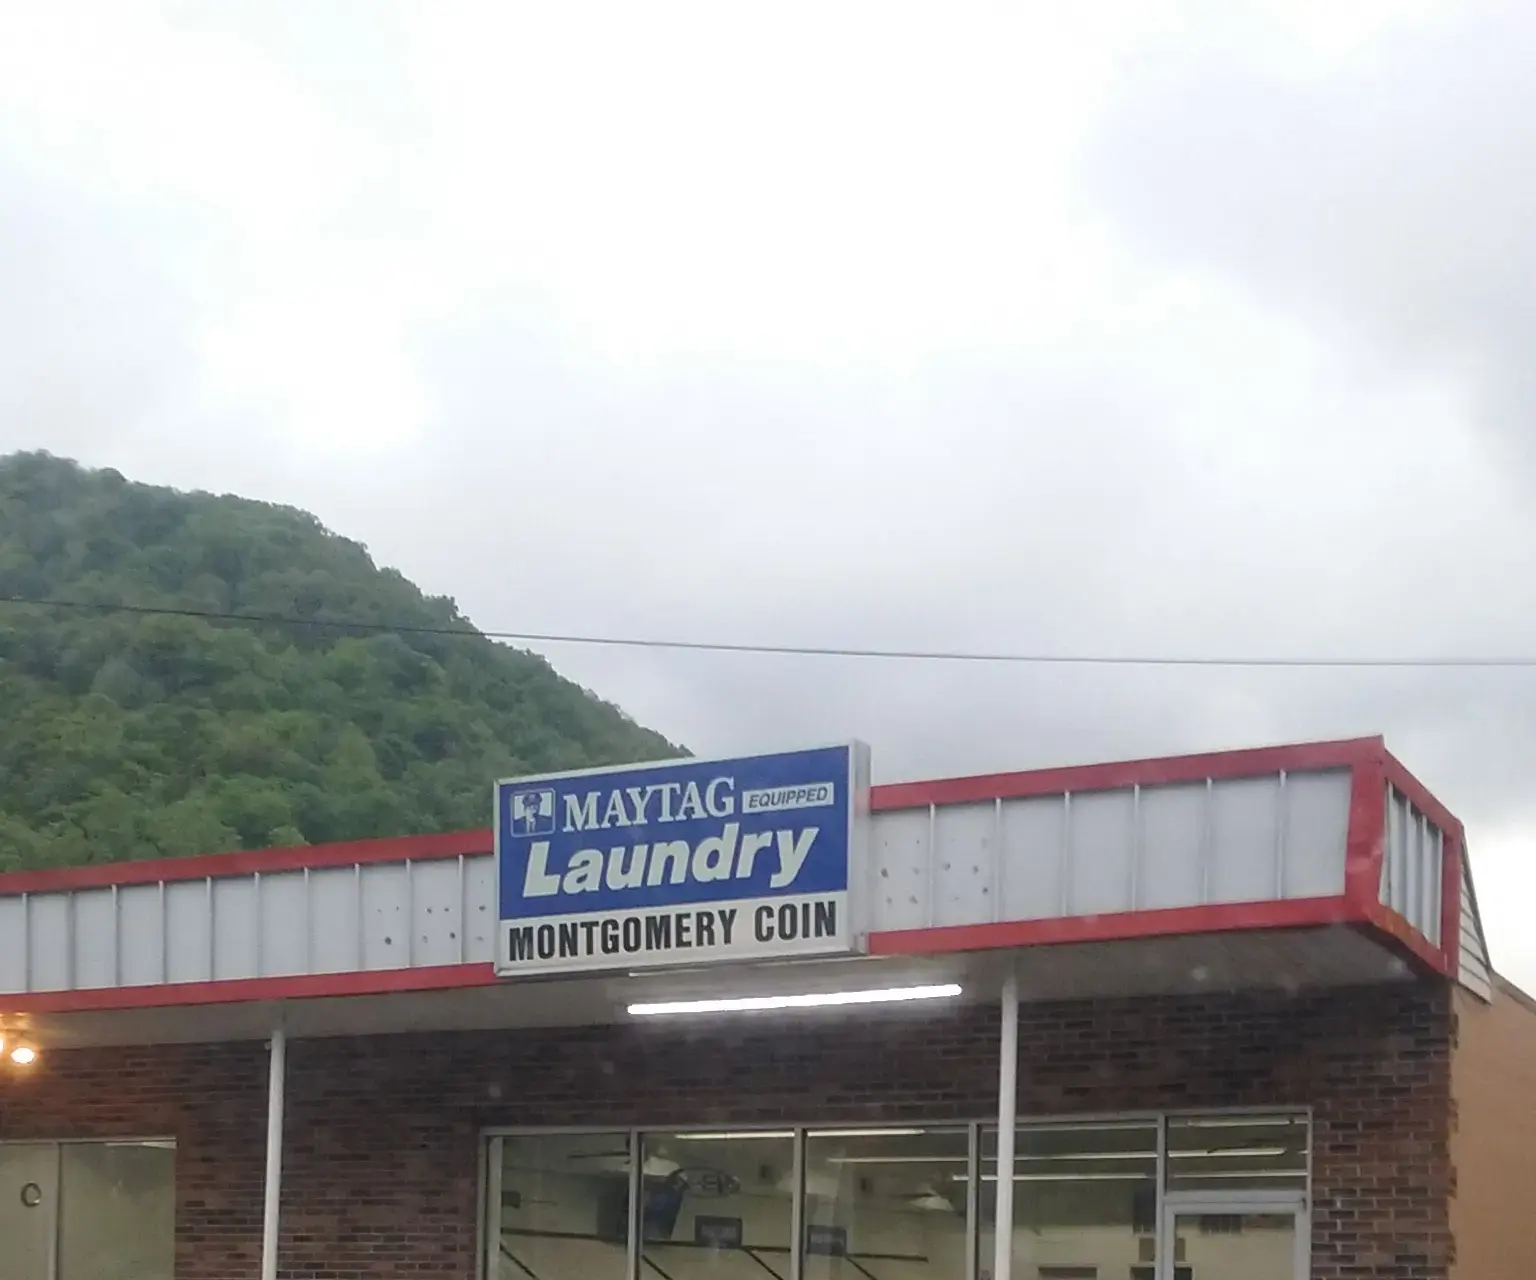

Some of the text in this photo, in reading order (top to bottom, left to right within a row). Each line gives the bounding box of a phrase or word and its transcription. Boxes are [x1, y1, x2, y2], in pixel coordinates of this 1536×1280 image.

[562, 776, 828, 833] MAYTAG EQUIPPED
[522, 822, 819, 898] Laundry
[509, 900, 836, 961] MONTGOMERY COIN
